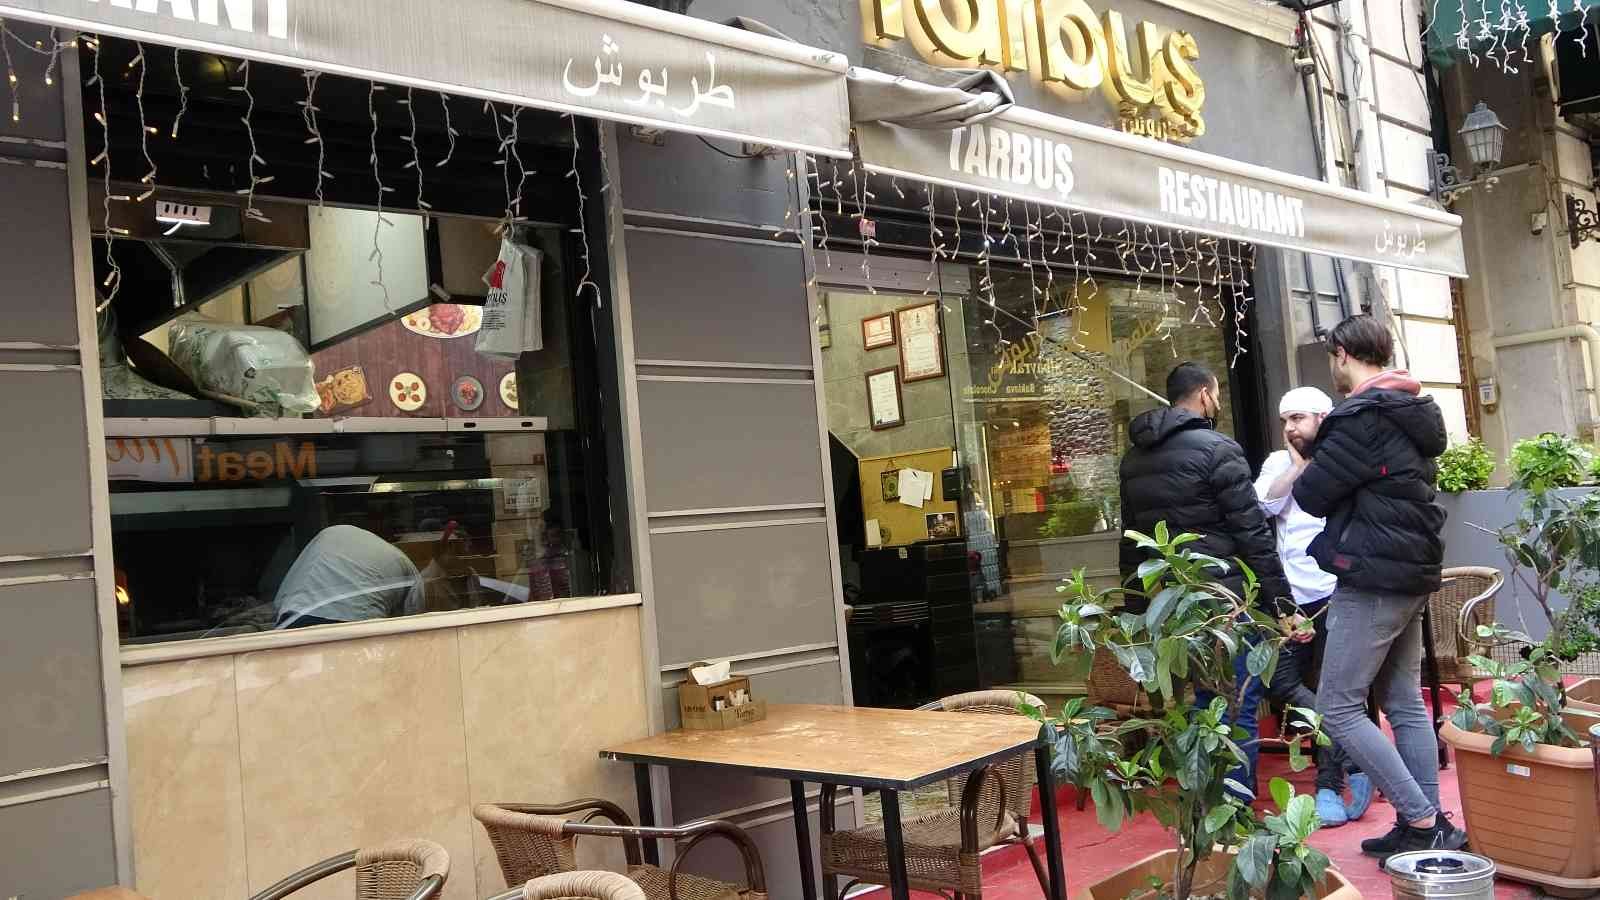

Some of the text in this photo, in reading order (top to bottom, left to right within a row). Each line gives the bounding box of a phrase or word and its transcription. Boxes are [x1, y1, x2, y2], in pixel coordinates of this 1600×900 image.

[563, 34, 736, 117] طربوش
[949, 122, 1306, 238] TARBUŞ RESTAURANT
[1375, 219, 1427, 258] طربوش
